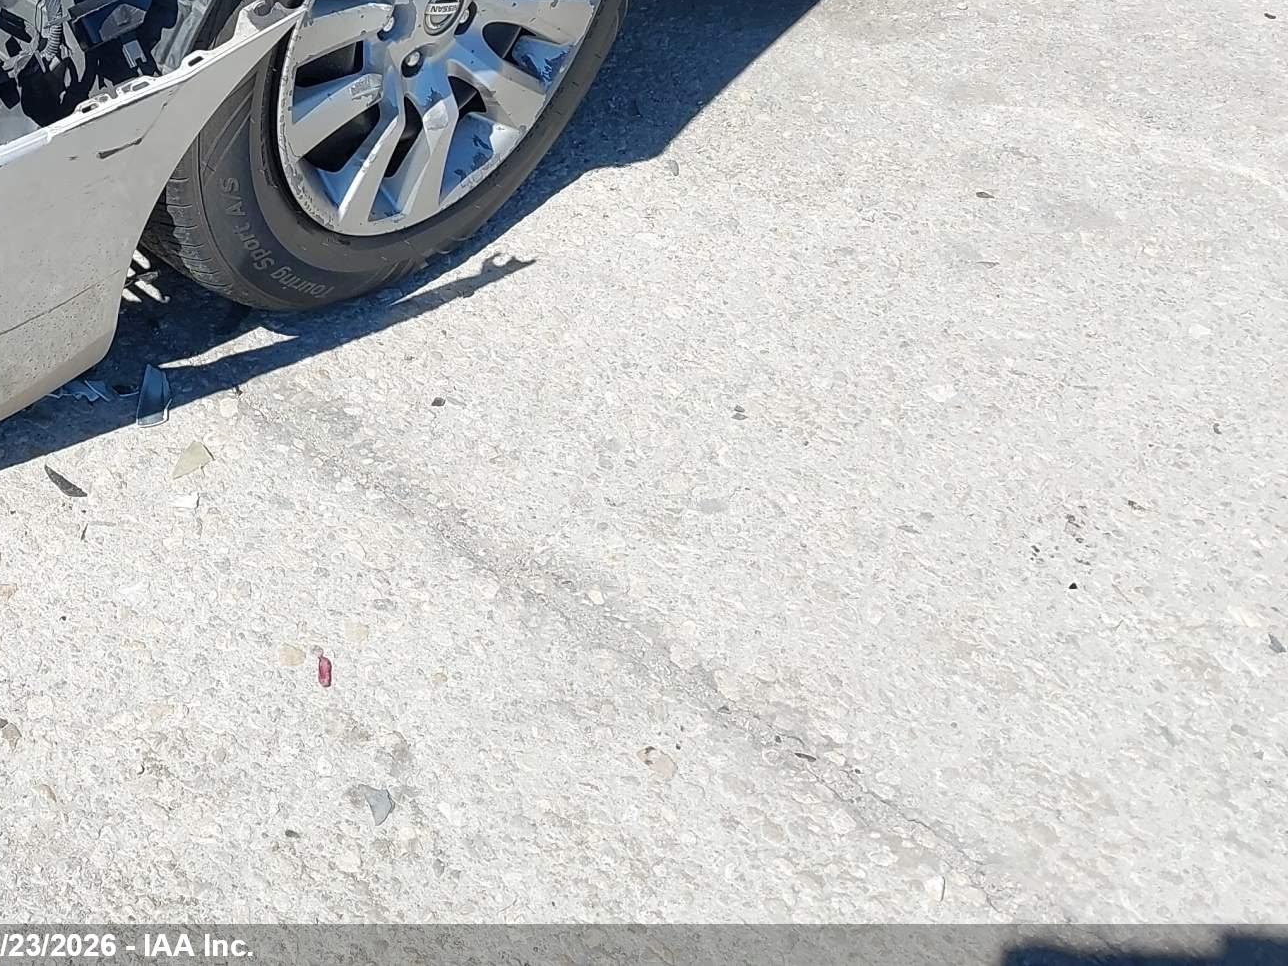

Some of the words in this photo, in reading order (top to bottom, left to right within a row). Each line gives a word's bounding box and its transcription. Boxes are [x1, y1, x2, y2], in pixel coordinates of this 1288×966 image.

[221, 177, 247, 216] A/S
[233, 221, 275, 271] Sport
[269, 265, 336, 299] Touring
